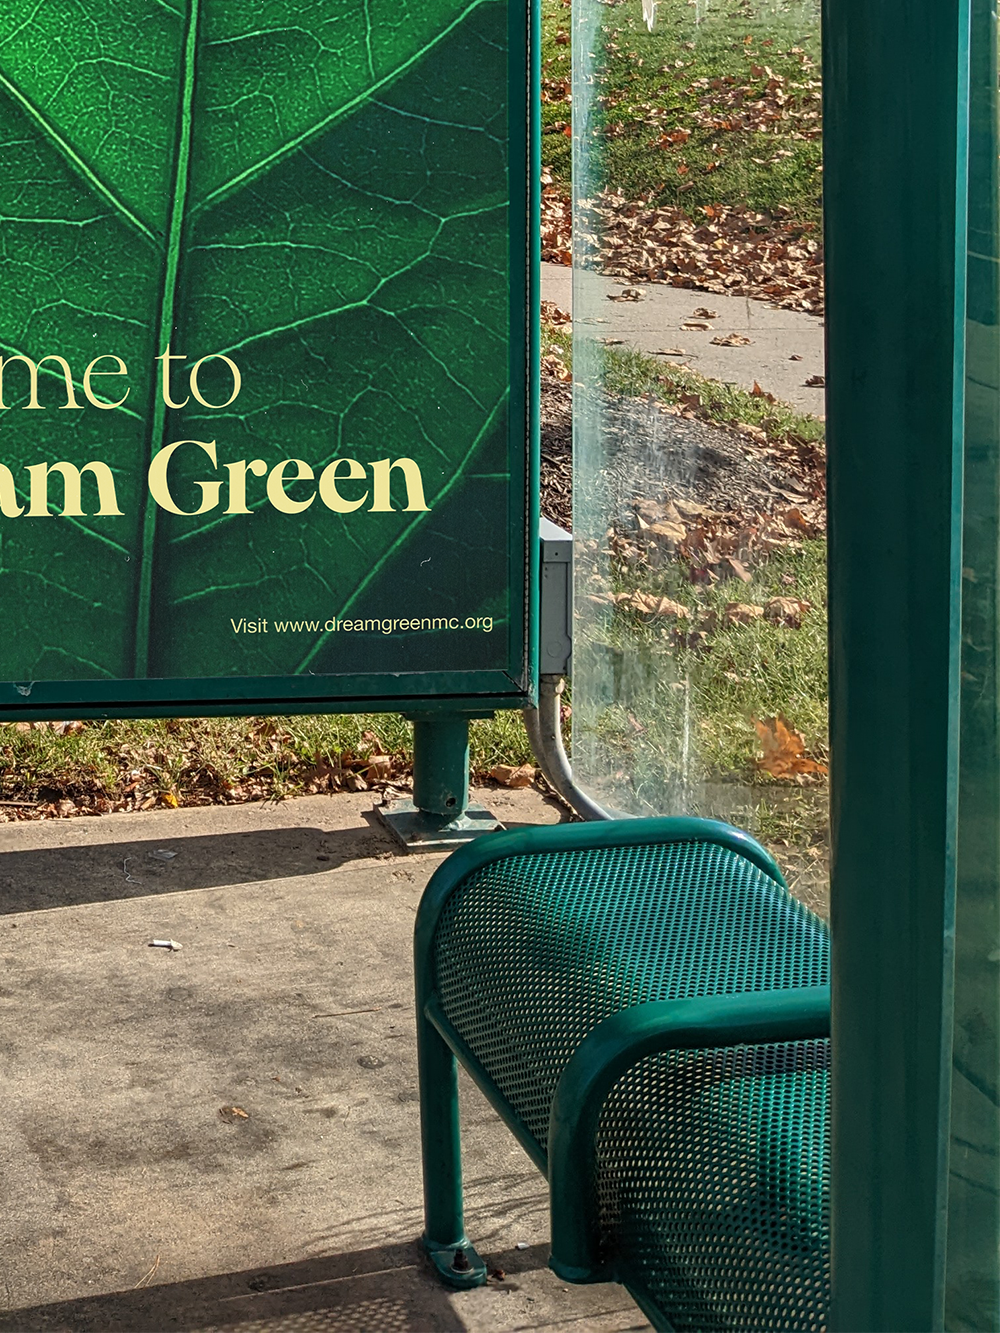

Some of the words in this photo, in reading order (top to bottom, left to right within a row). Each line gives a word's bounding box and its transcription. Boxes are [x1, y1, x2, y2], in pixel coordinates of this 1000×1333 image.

[154, 343, 243, 409] to
[147, 440, 433, 516] Green
[230, 618, 268, 634] Visit
[274, 616, 493, 635] www.dreamgreenmc.org
